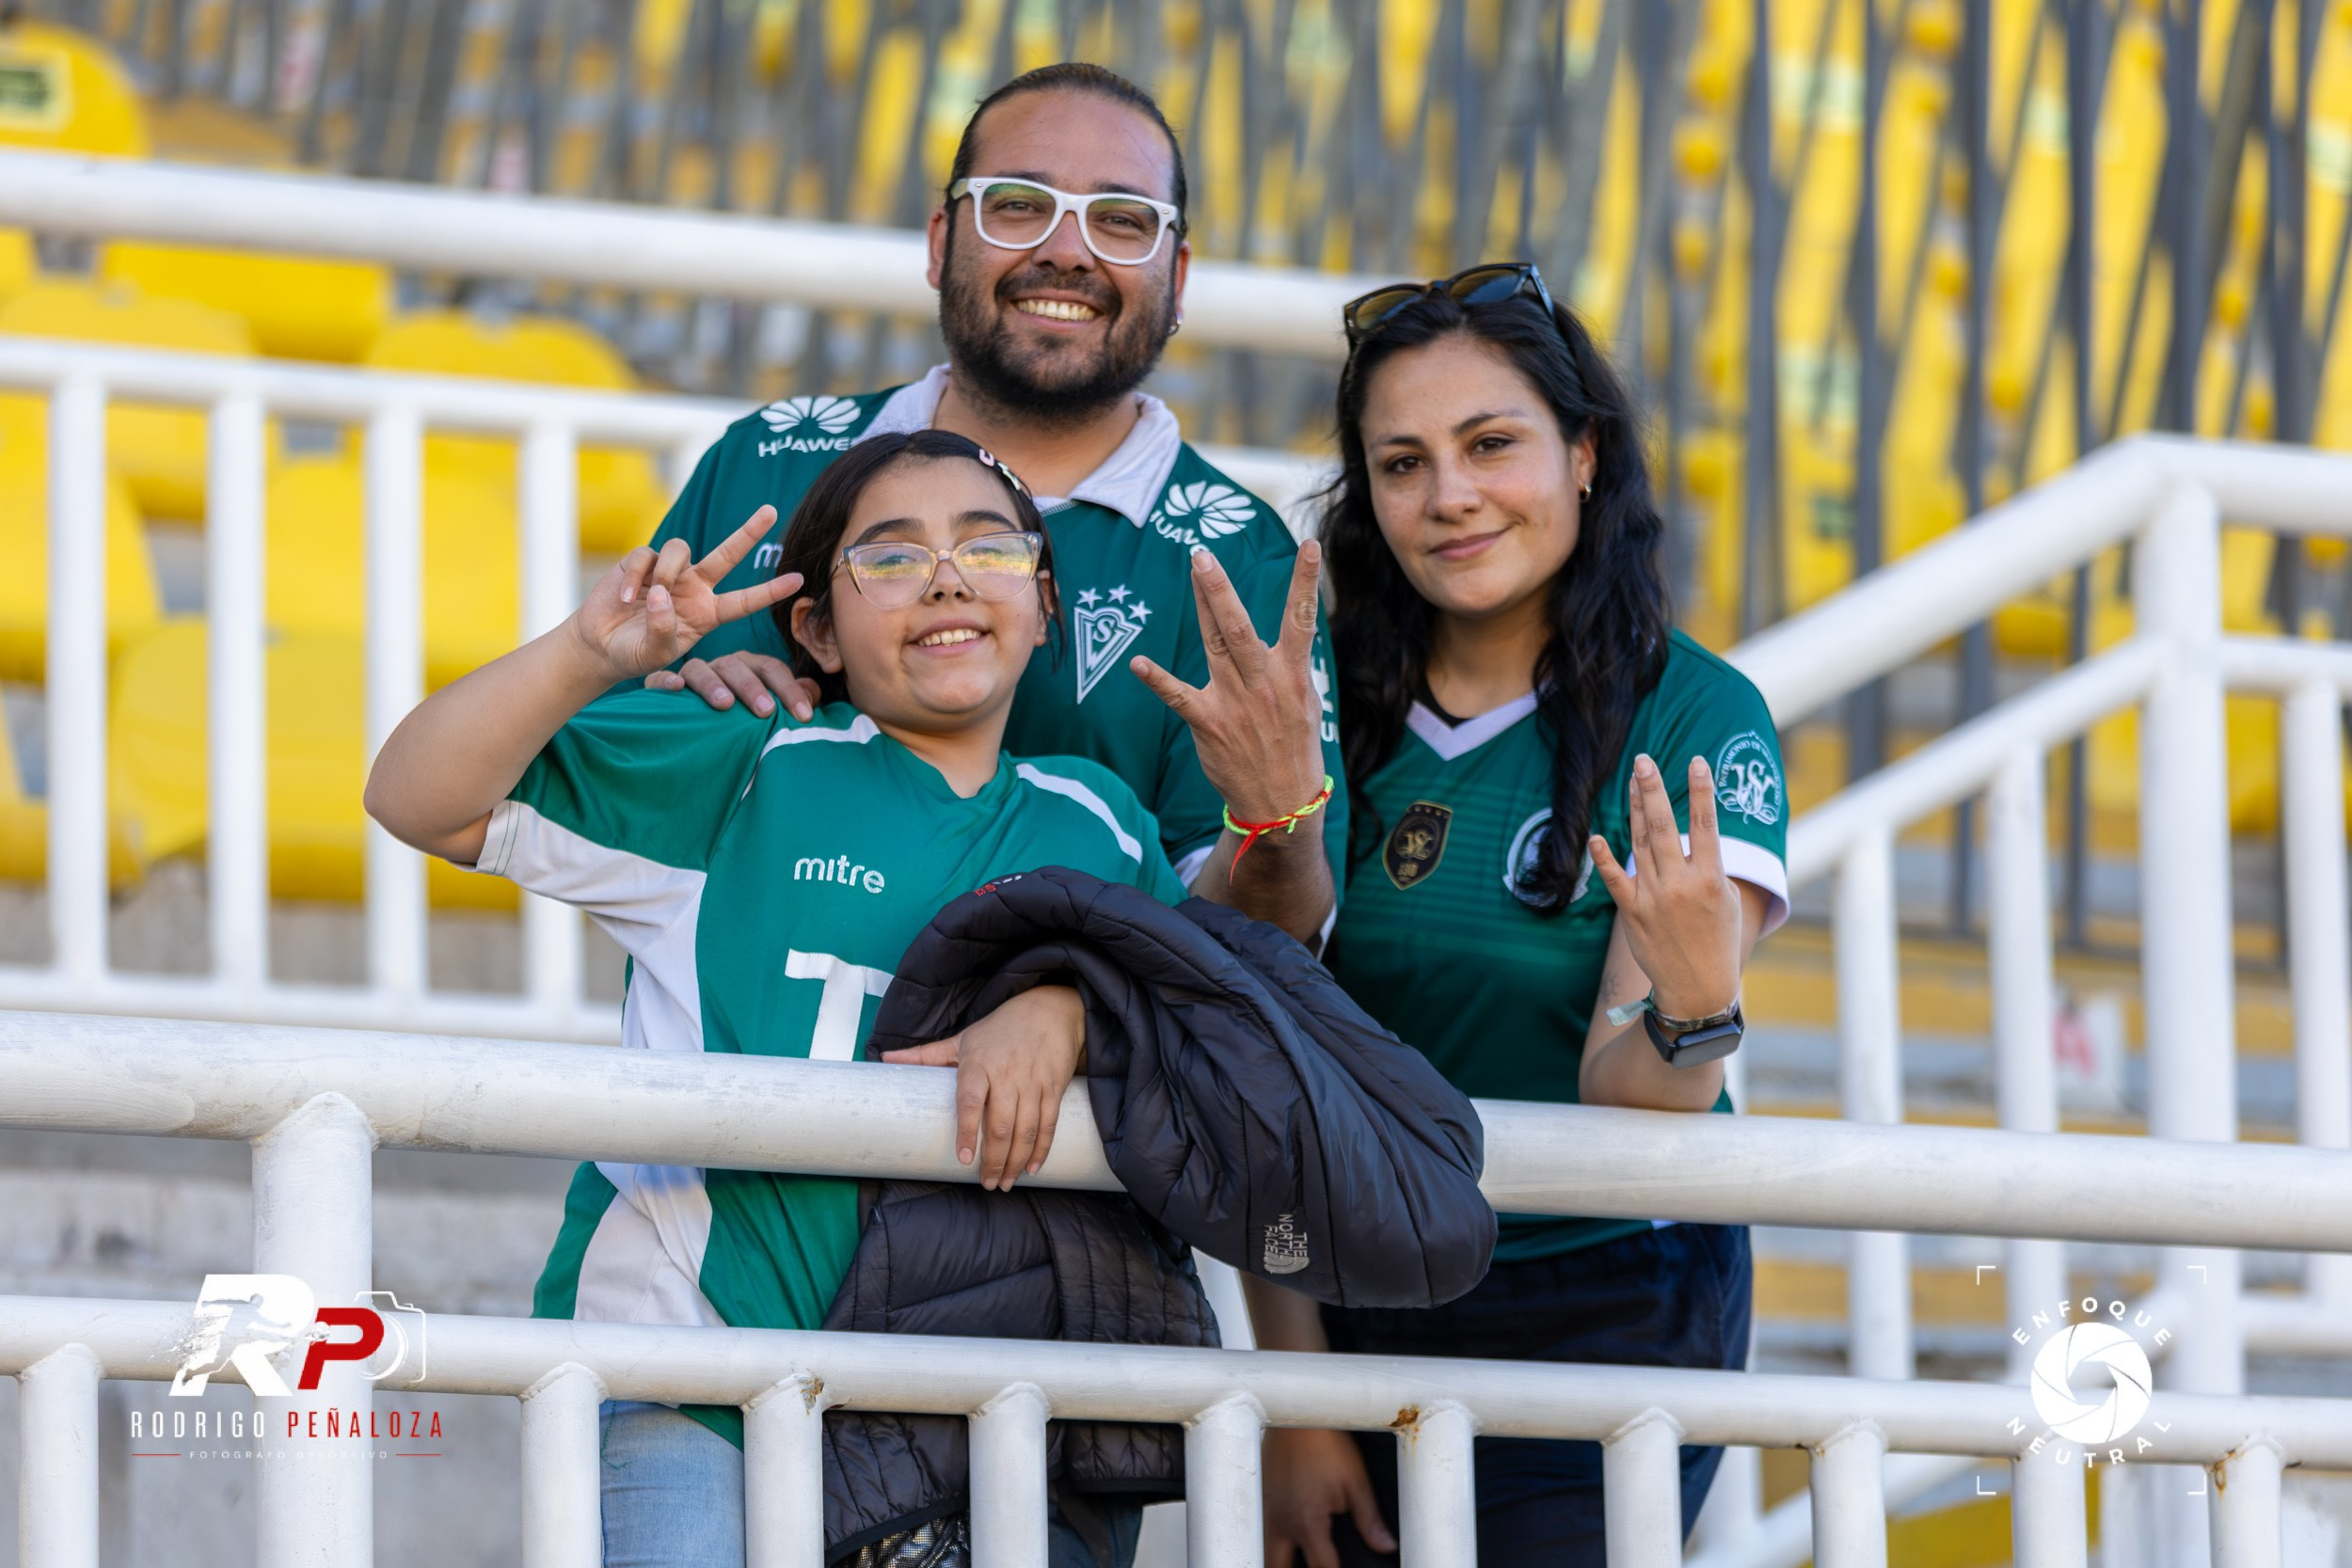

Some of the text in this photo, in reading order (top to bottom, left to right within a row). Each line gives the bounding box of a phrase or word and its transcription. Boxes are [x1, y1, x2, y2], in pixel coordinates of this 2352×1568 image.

[793, 854, 885, 895] mitre
[1263, 1225, 1279, 1255] FACE
[1279, 1213, 1294, 1257] NORTH
[1293, 1231, 1308, 1257] THE
